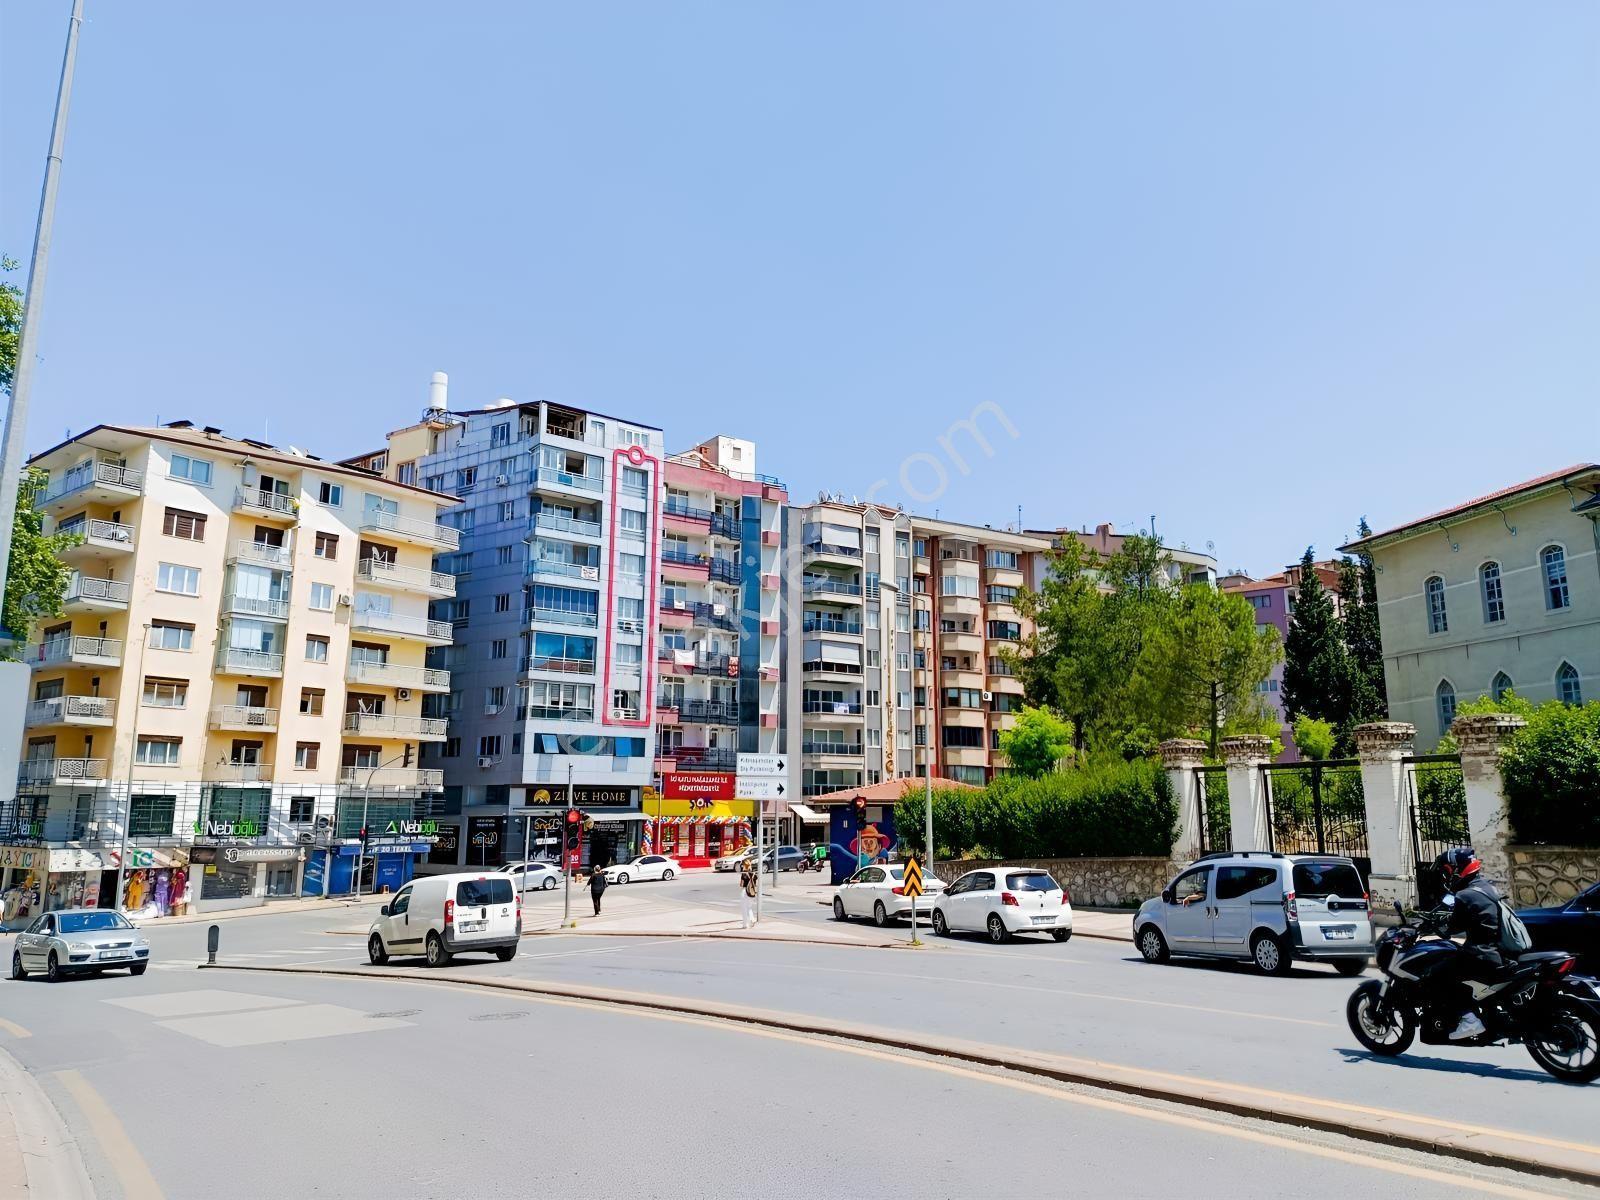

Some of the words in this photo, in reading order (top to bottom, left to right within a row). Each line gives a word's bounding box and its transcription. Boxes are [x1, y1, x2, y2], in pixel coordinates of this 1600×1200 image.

[554, 790, 588, 801] ZİVE
[592, 791, 626, 802] HOME
[206, 820, 259, 837] Nebioğlu
[400, 820, 440, 836] Nebioğlu
